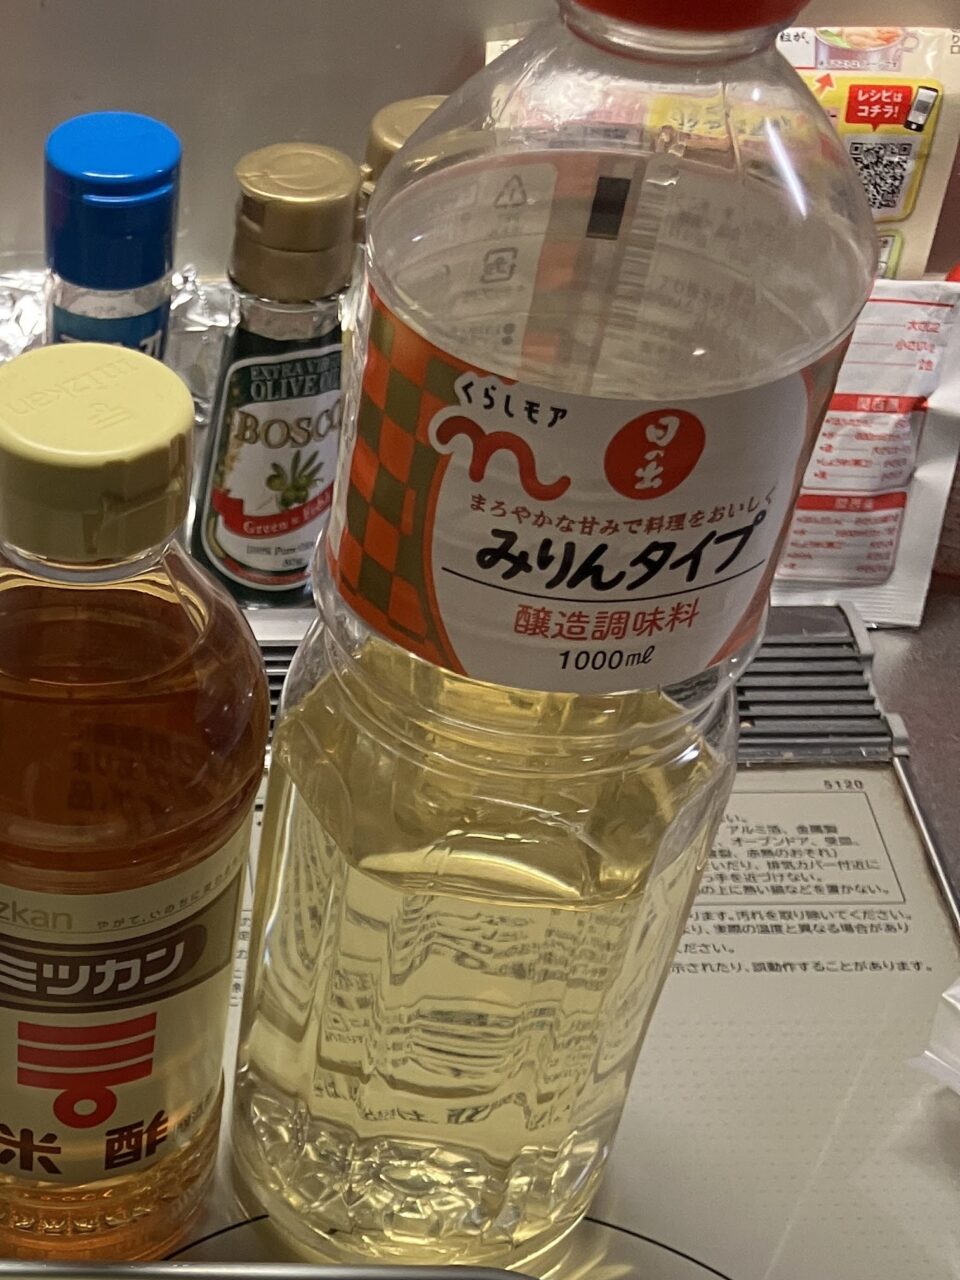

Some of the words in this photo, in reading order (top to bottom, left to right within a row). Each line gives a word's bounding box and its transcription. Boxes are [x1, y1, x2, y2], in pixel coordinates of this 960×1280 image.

[857, 90, 903, 101] レシピは
[857, 104, 899, 118] コチラ!
[250, 374, 317, 402] OLIVE
[461, 380, 567, 428] くらしモア
[634, 415, 680, 490] 日の出
[475, 510, 767, 592] みりんタイプ
[514, 598, 700, 642] 醸造調味料
[823, 779, 864, 790] 5120
